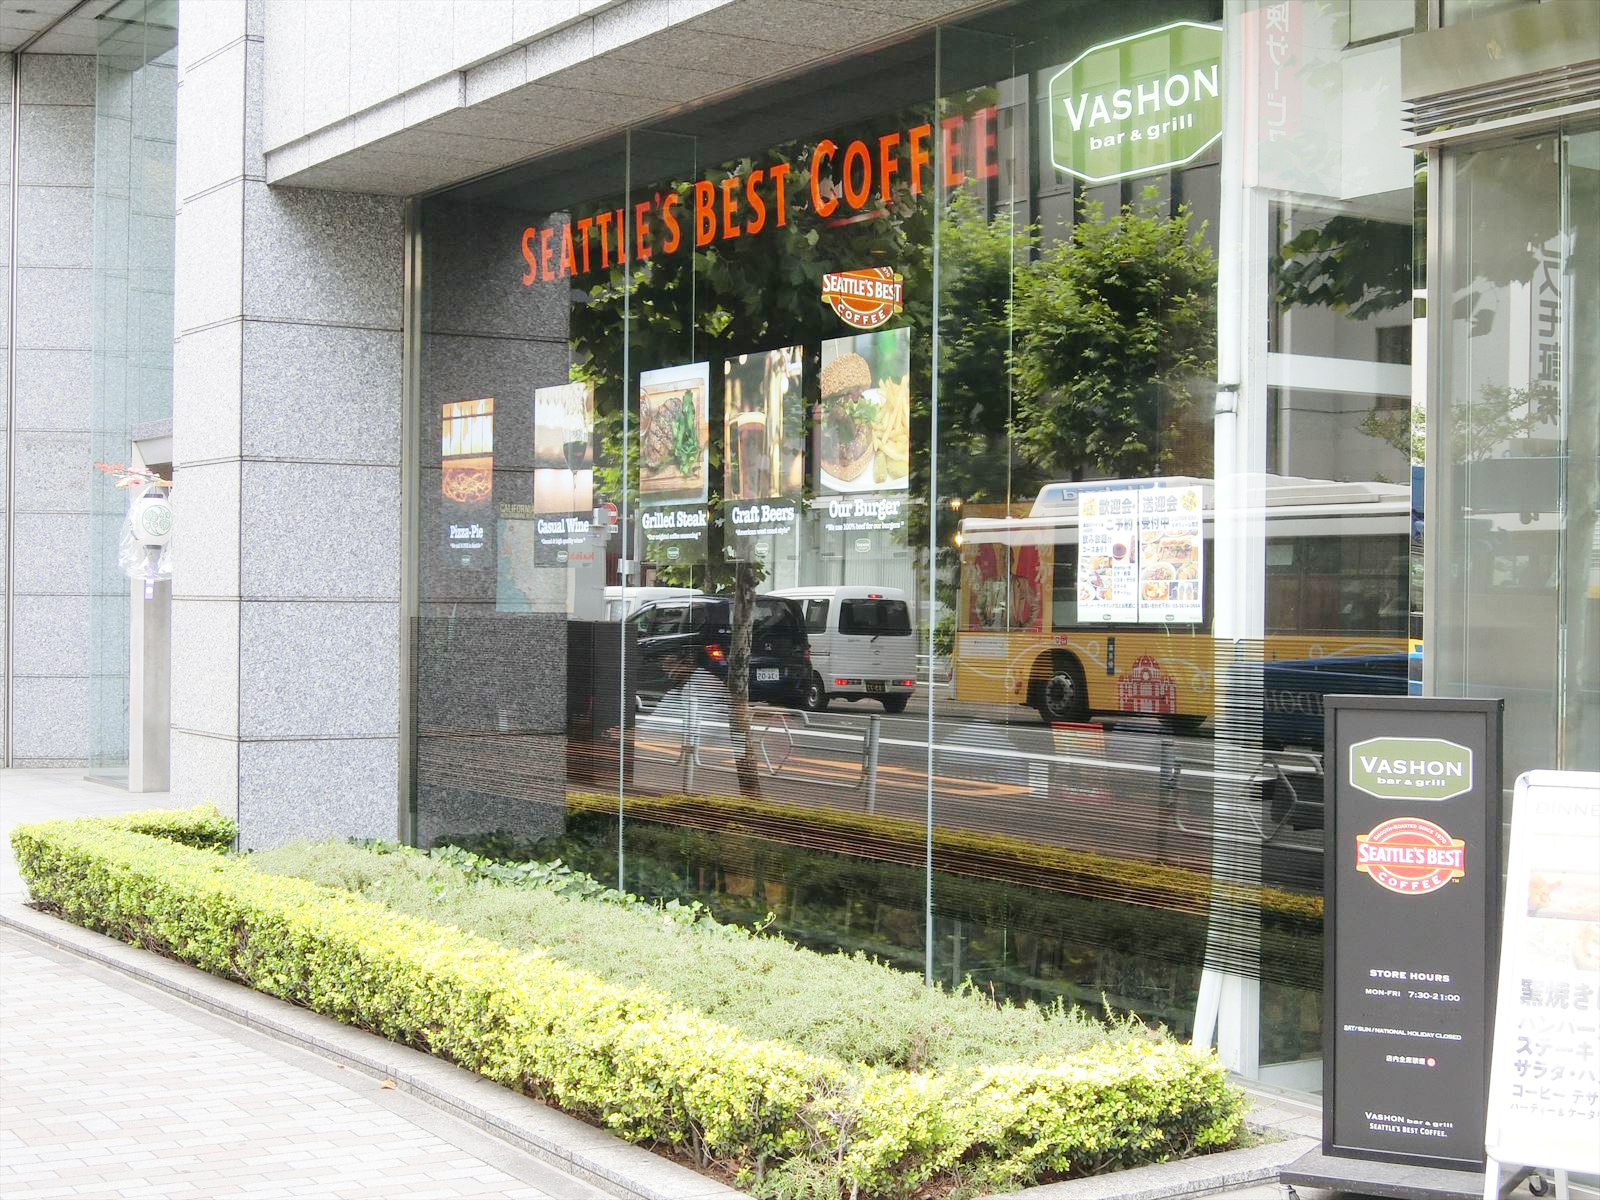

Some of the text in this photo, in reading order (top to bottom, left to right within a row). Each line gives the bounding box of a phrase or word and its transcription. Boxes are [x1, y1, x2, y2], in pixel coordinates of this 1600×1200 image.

[1063, 64, 1219, 132] VASHON
[1089, 113, 1193, 150] bar & grill
[520, 104, 999, 287] SEATTLE'S BEST COFFEE
[823, 273, 902, 303] SEATTLE'S BEST
[838, 303, 886, 325] COFFEE
[732, 504, 795, 524] Craft Beers
[829, 499, 900, 520] Our Burger
[538, 519, 565, 535] Casual
[567, 517, 590, 533] Wine
[642, 510, 707, 529] Grilled Steak
[1141, 516, 1169, 530] 受付中
[449, 523, 484, 539] Pizza-Pie
[1360, 756, 1462, 777] VASHON
[1377, 777, 1404, 785] bar
[1415, 779, 1446, 787] grill
[1434, 831, 1447, 844] 1970
[1359, 843, 1463, 867] SEATTLE'S BEST
[1378, 871, 1441, 890] COFFEE
[1369, 969, 1450, 982] STORE HOURS
[1365, 988, 1461, 1002] MON-FRI 7:30-21:00
[1517, 1036, 1594, 1061] ステーキ
[1365, 1111, 1405, 1123] VASHON
[1369, 1123, 1401, 1133] SEATTLE'S
[1402, 1126, 1419, 1134] BEST
